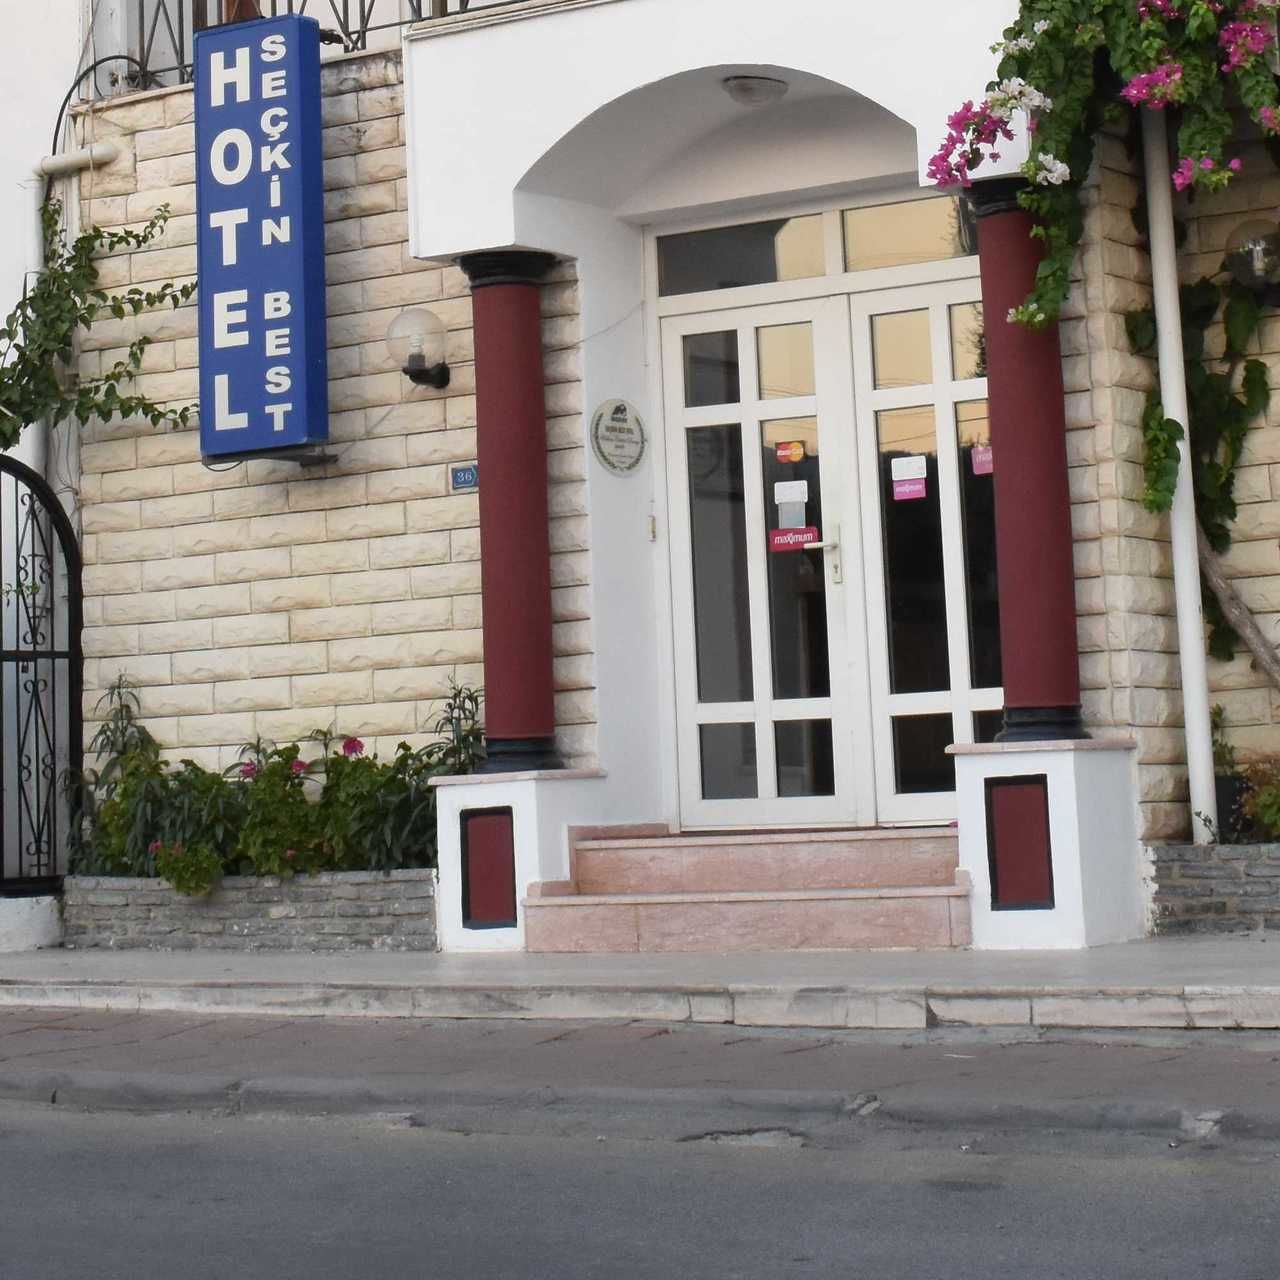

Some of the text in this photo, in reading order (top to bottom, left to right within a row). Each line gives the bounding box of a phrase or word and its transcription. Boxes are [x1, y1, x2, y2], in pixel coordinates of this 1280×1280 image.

[210, 47, 253, 431] HOTEL
[260, 34, 293, 431] SEÇKİN BEST
